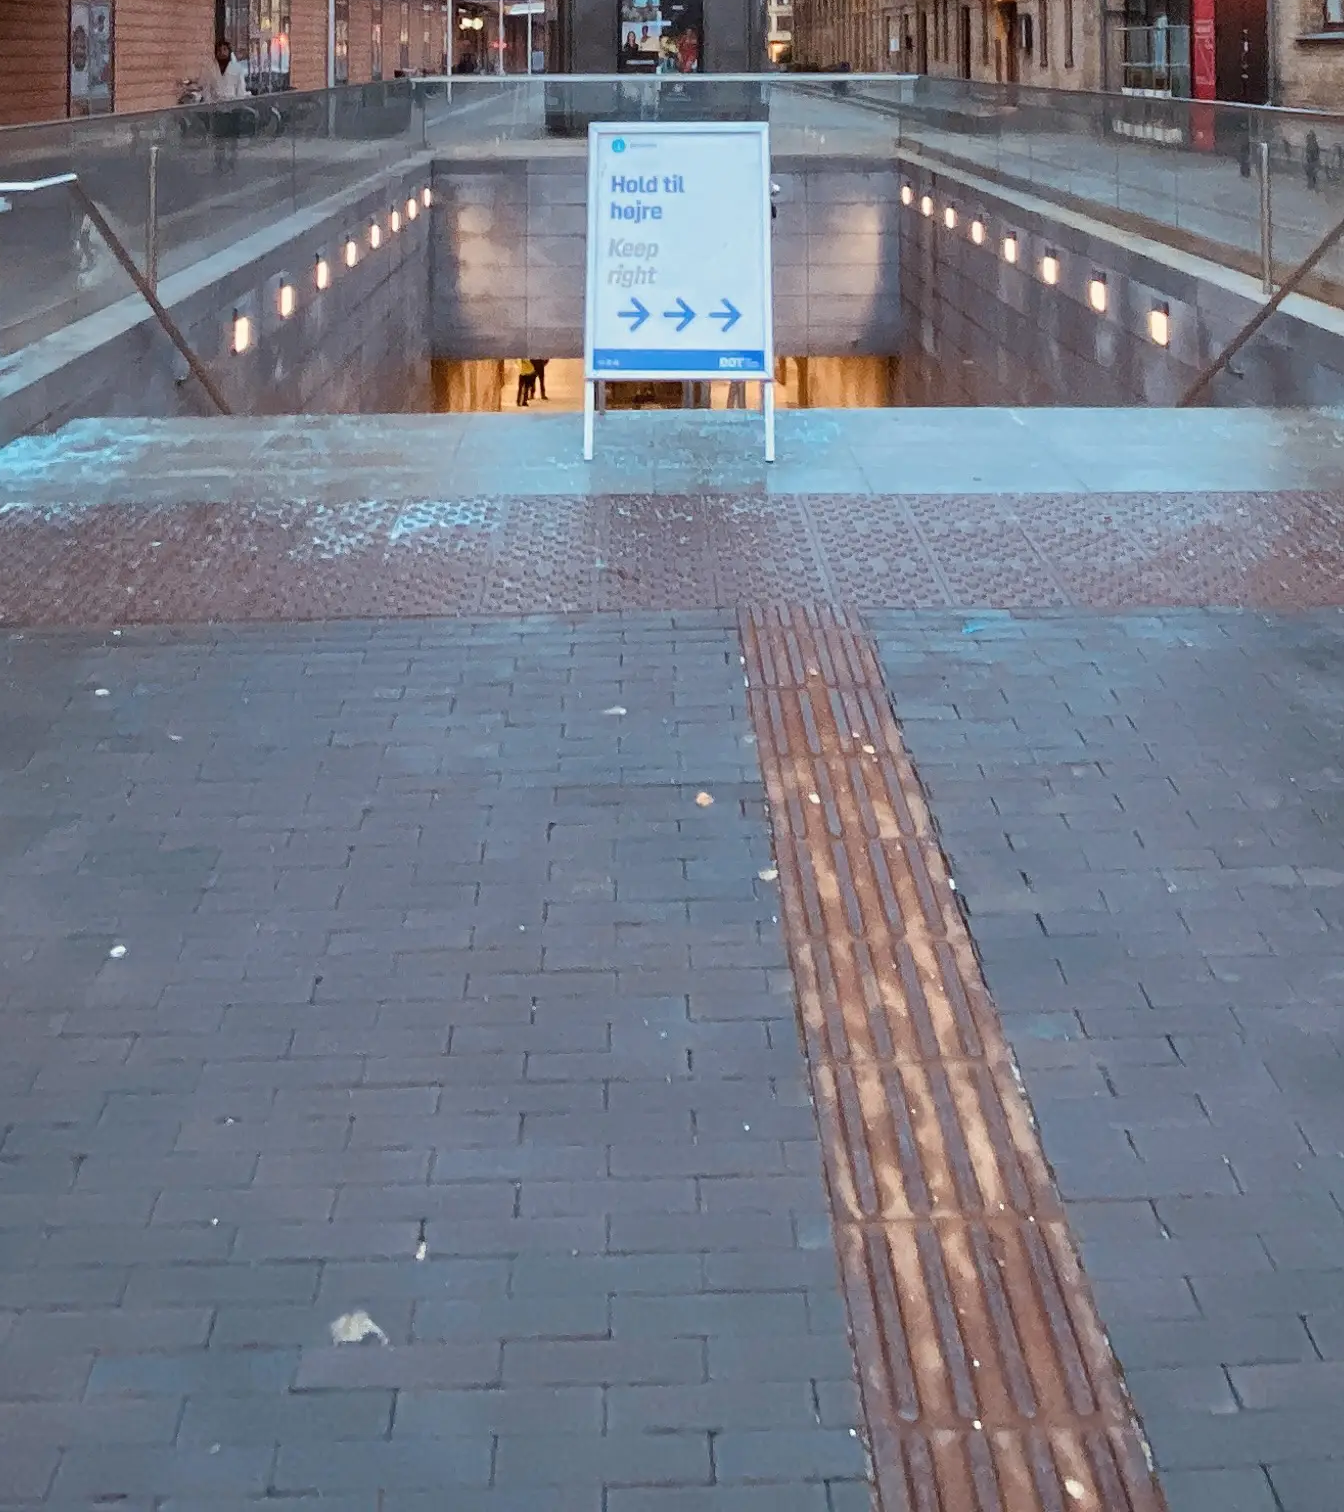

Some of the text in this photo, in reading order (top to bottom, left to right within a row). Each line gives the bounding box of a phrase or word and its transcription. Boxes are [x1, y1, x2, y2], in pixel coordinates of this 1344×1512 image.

[611, 174, 685, 193] Hold til
[610, 200, 662, 224] højre
[608, 237, 659, 261] Keep
[607, 264, 657, 288] right
